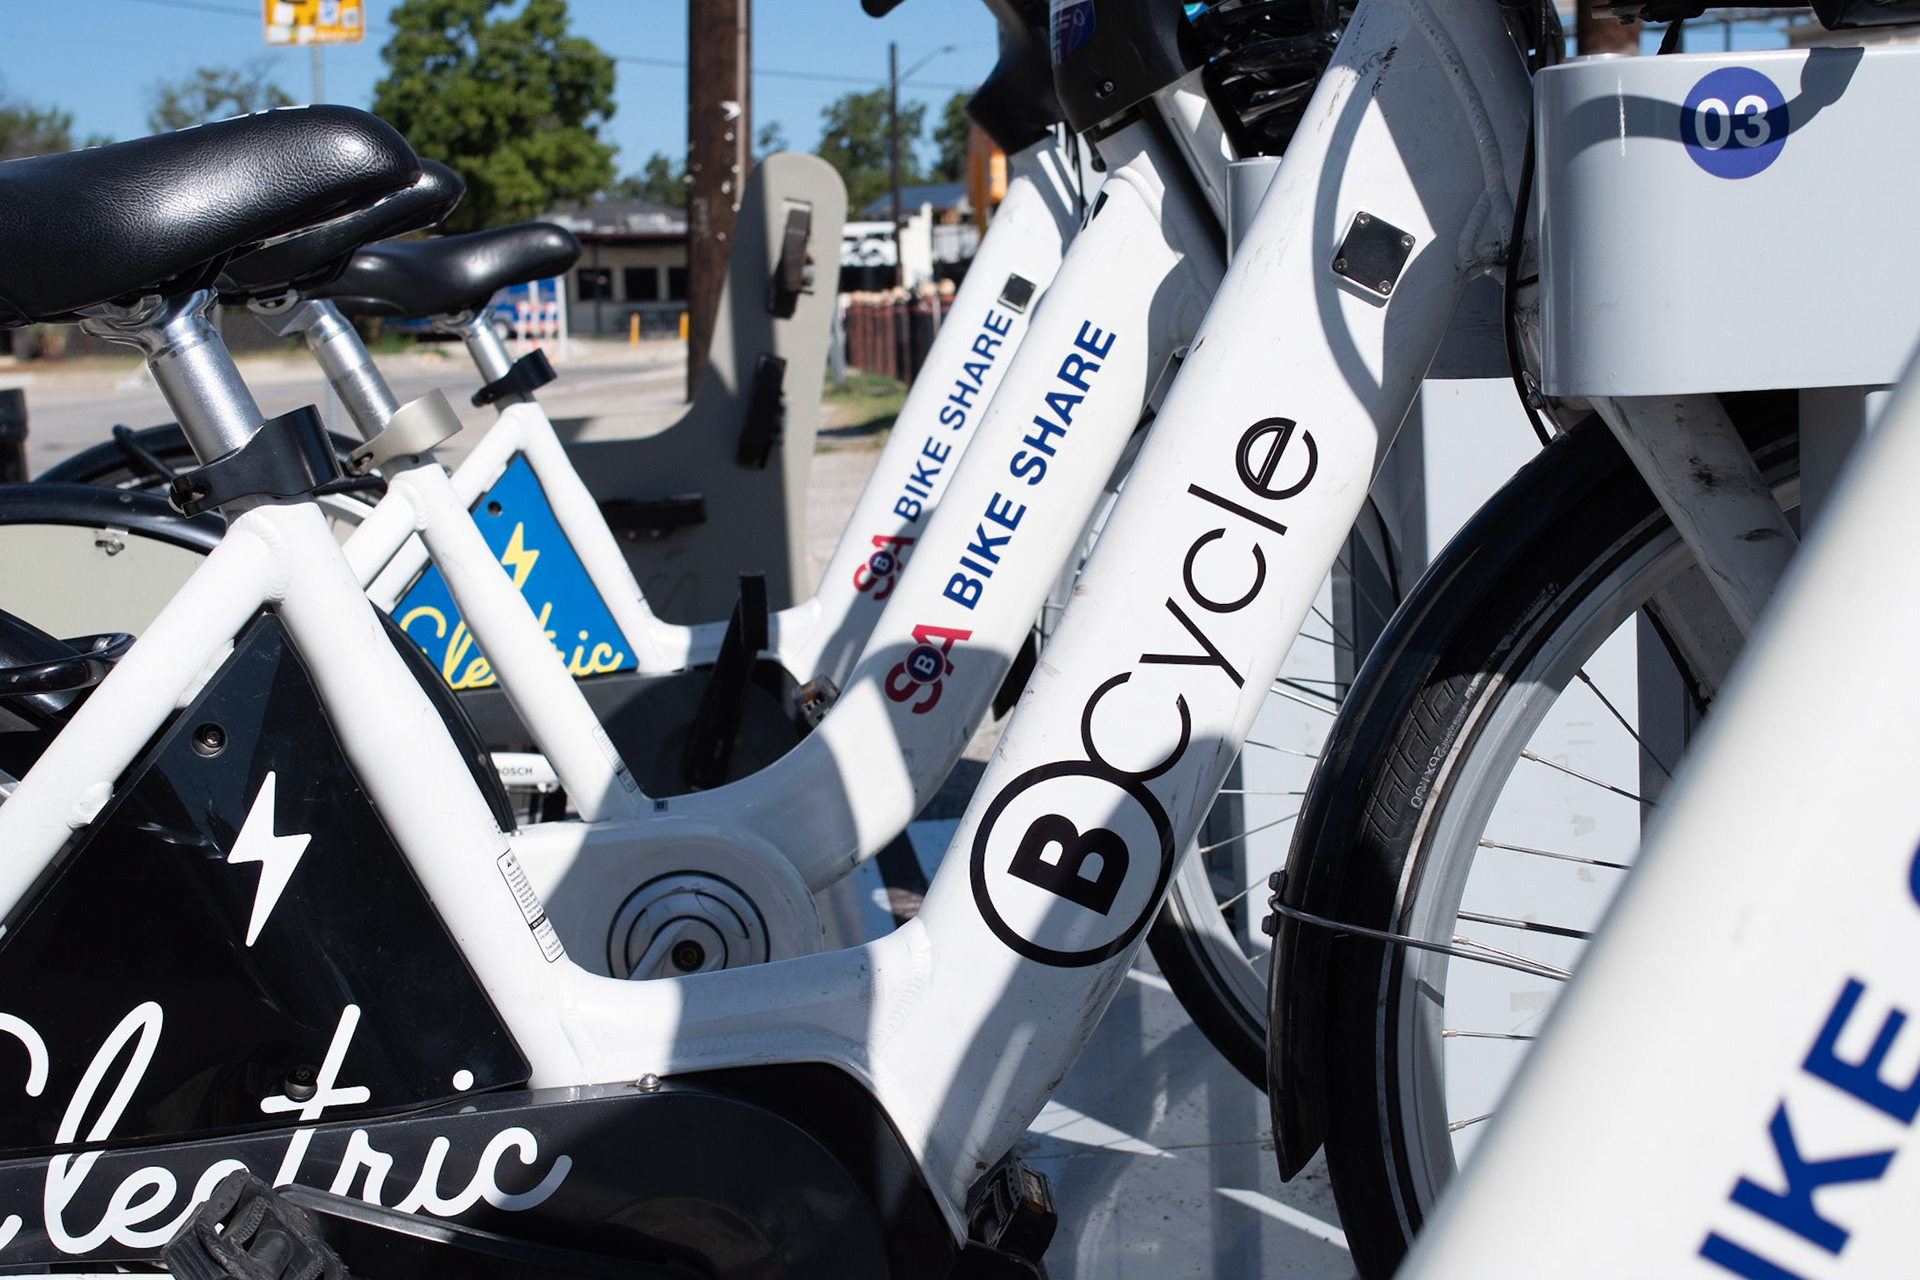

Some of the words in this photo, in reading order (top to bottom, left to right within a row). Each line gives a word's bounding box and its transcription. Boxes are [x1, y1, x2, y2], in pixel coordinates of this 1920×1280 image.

[1694, 94, 1772, 151] 03
[893, 437, 952, 525] BIKE
[939, 309, 1013, 431] SHARE
[942, 491, 1027, 611] BIKE
[1009, 318, 1117, 486] SHARE
[499, 766, 533, 776] OSCH
